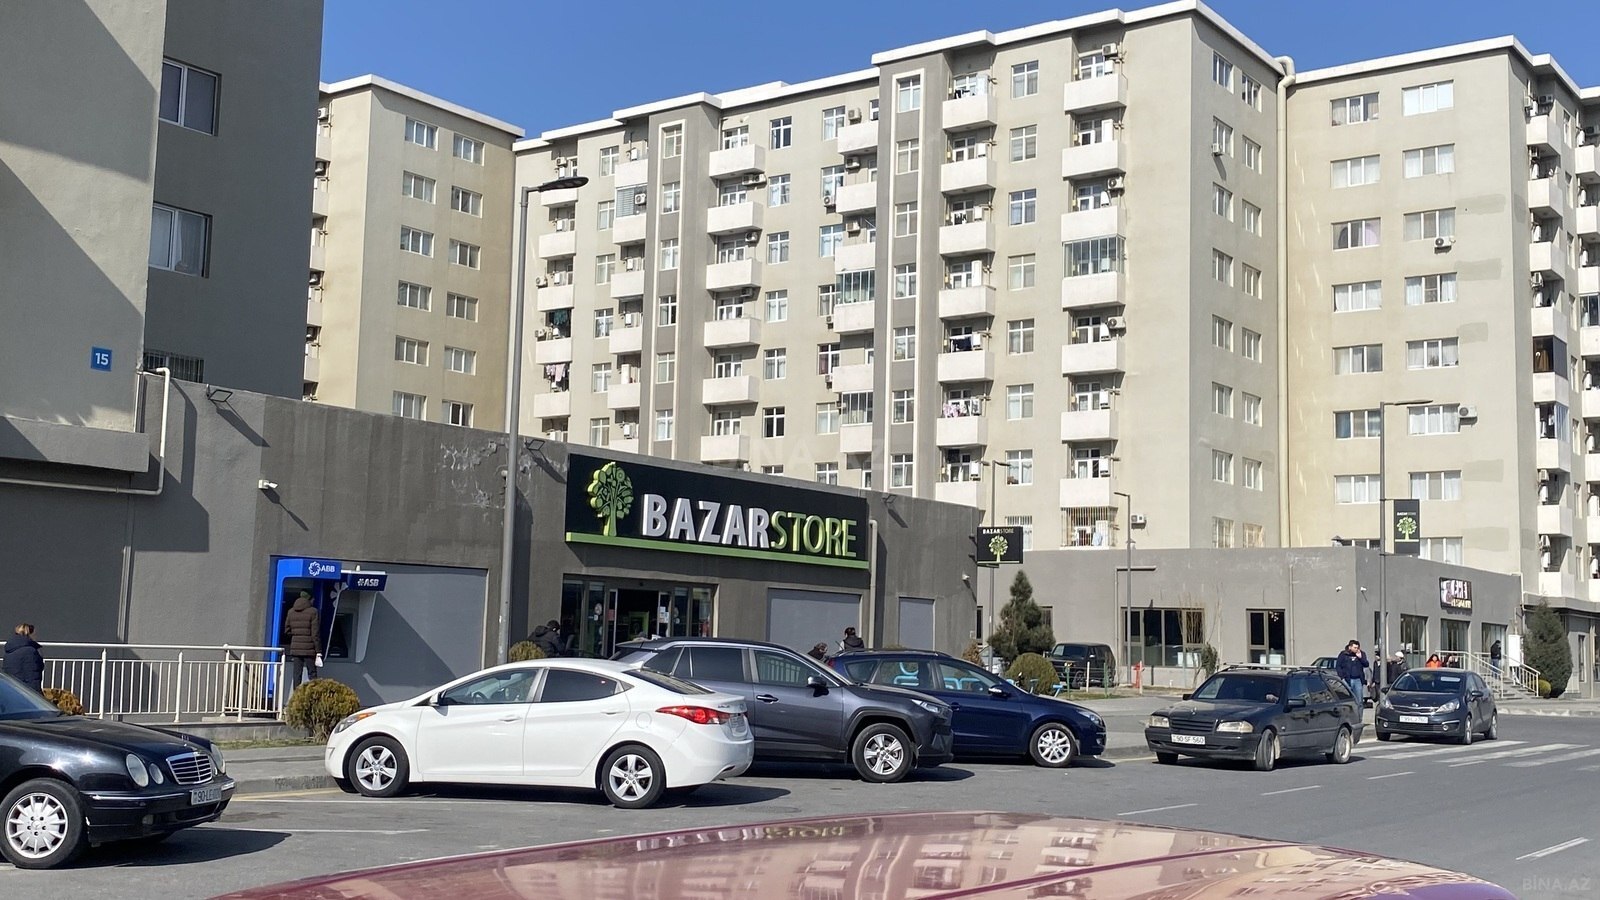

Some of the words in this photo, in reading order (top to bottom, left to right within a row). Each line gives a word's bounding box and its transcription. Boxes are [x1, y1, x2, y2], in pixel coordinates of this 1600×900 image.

[95, 352, 109, 366] 15
[641, 493, 858, 558] BAZARSTORE
[363, 578, 379, 587] ASB
